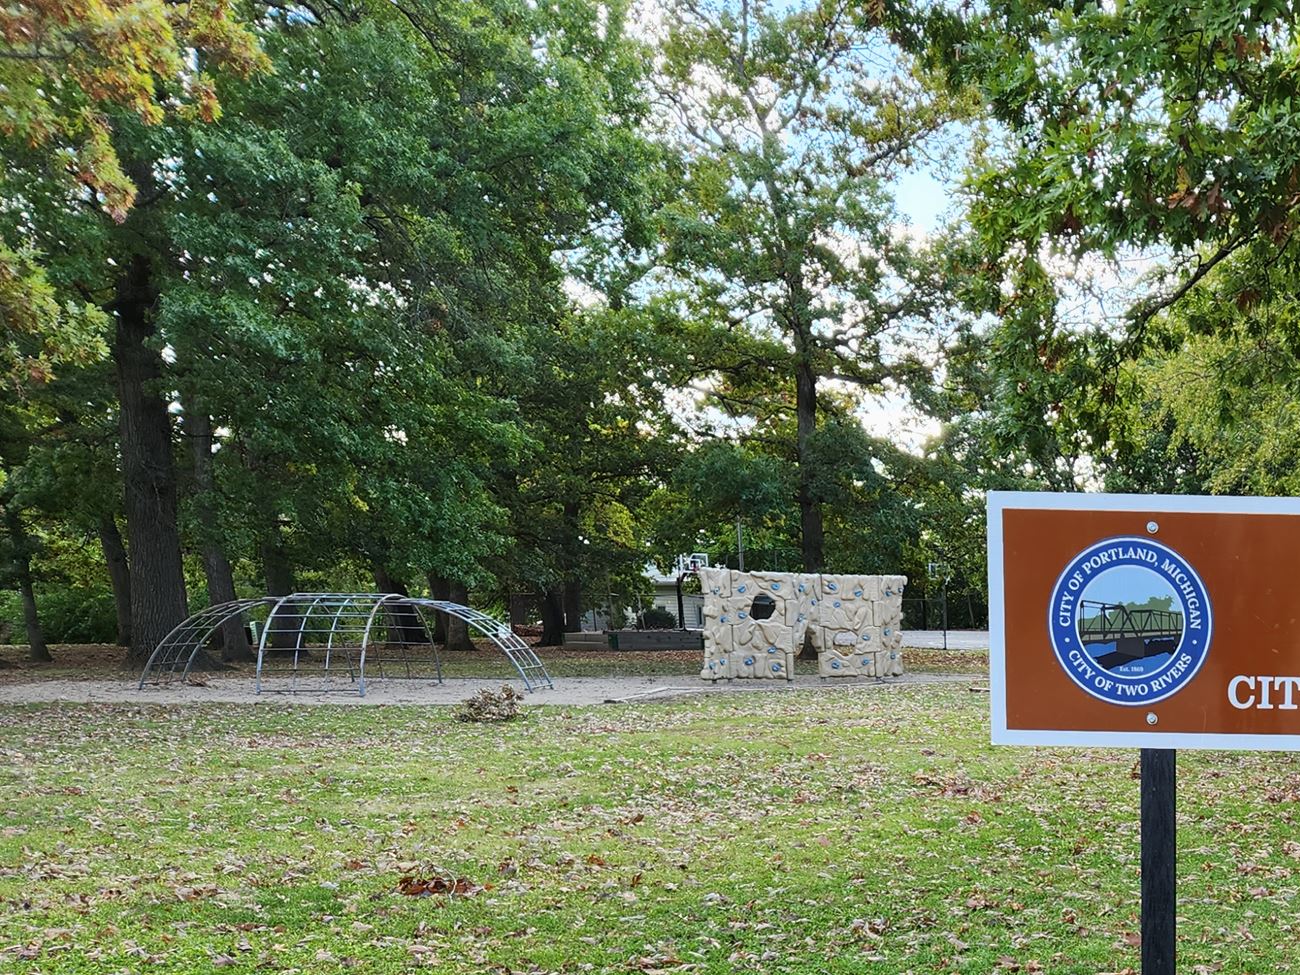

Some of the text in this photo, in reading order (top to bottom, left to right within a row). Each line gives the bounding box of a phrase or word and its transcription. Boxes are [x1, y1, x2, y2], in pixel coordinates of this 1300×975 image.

[1059, 546, 1201, 630] CITY OF PORTLAND, MICHIGAN
[1068, 649, 1193, 697] CITY OF TWO RIVERS
